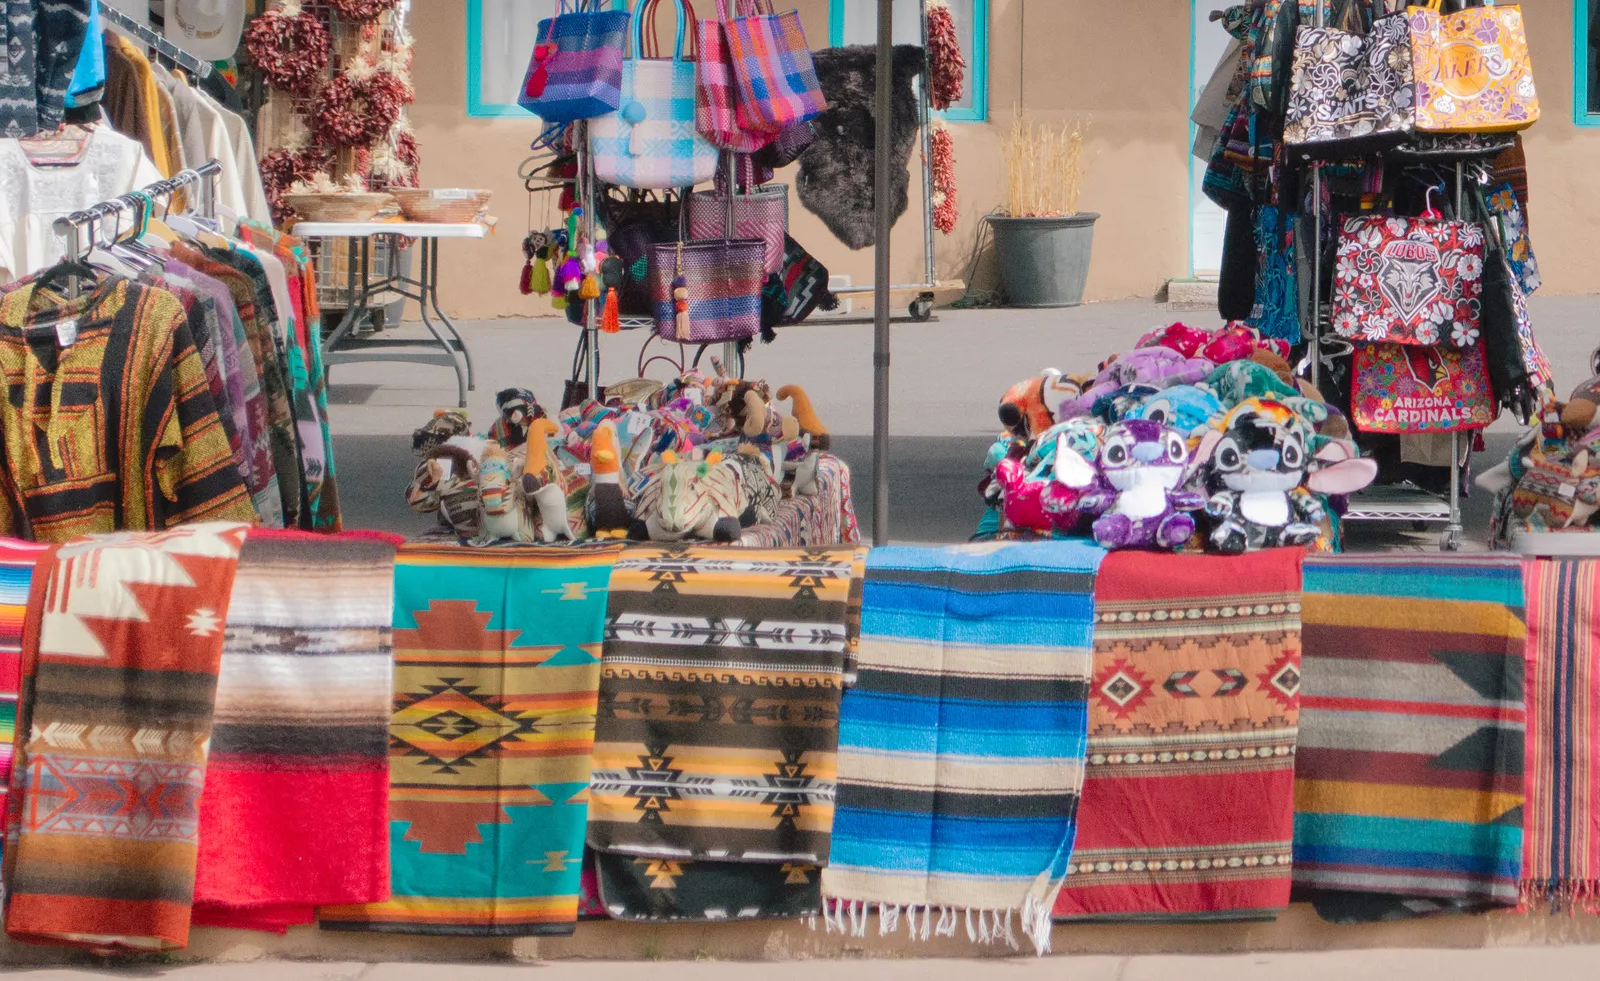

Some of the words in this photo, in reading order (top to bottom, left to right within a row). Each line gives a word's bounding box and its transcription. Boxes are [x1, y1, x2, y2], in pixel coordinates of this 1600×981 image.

[1325, 99, 1344, 107] NEW
[1385, 243, 1438, 262] LOBOS
[1394, 396, 1452, 408] ARIZONA
[1373, 407, 1472, 423] CARDINALS
